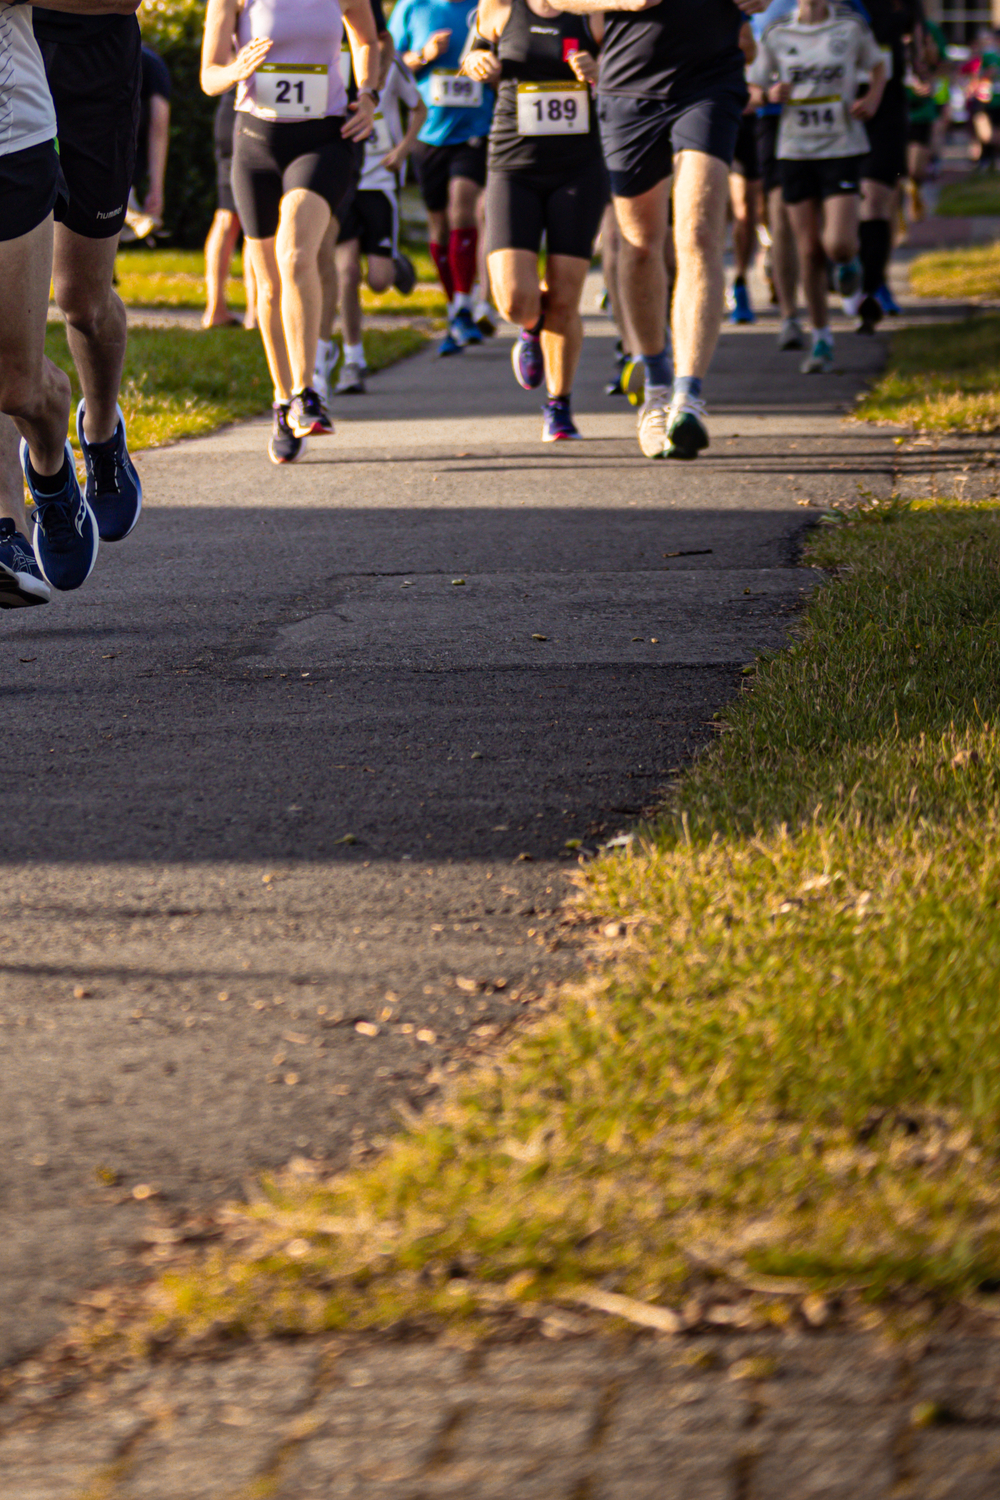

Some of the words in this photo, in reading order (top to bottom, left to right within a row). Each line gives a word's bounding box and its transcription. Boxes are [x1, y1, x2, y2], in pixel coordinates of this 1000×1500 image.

[275, 80, 304, 104] 21
[532, 99, 577, 121] 189
[798, 109, 834, 128] 314
